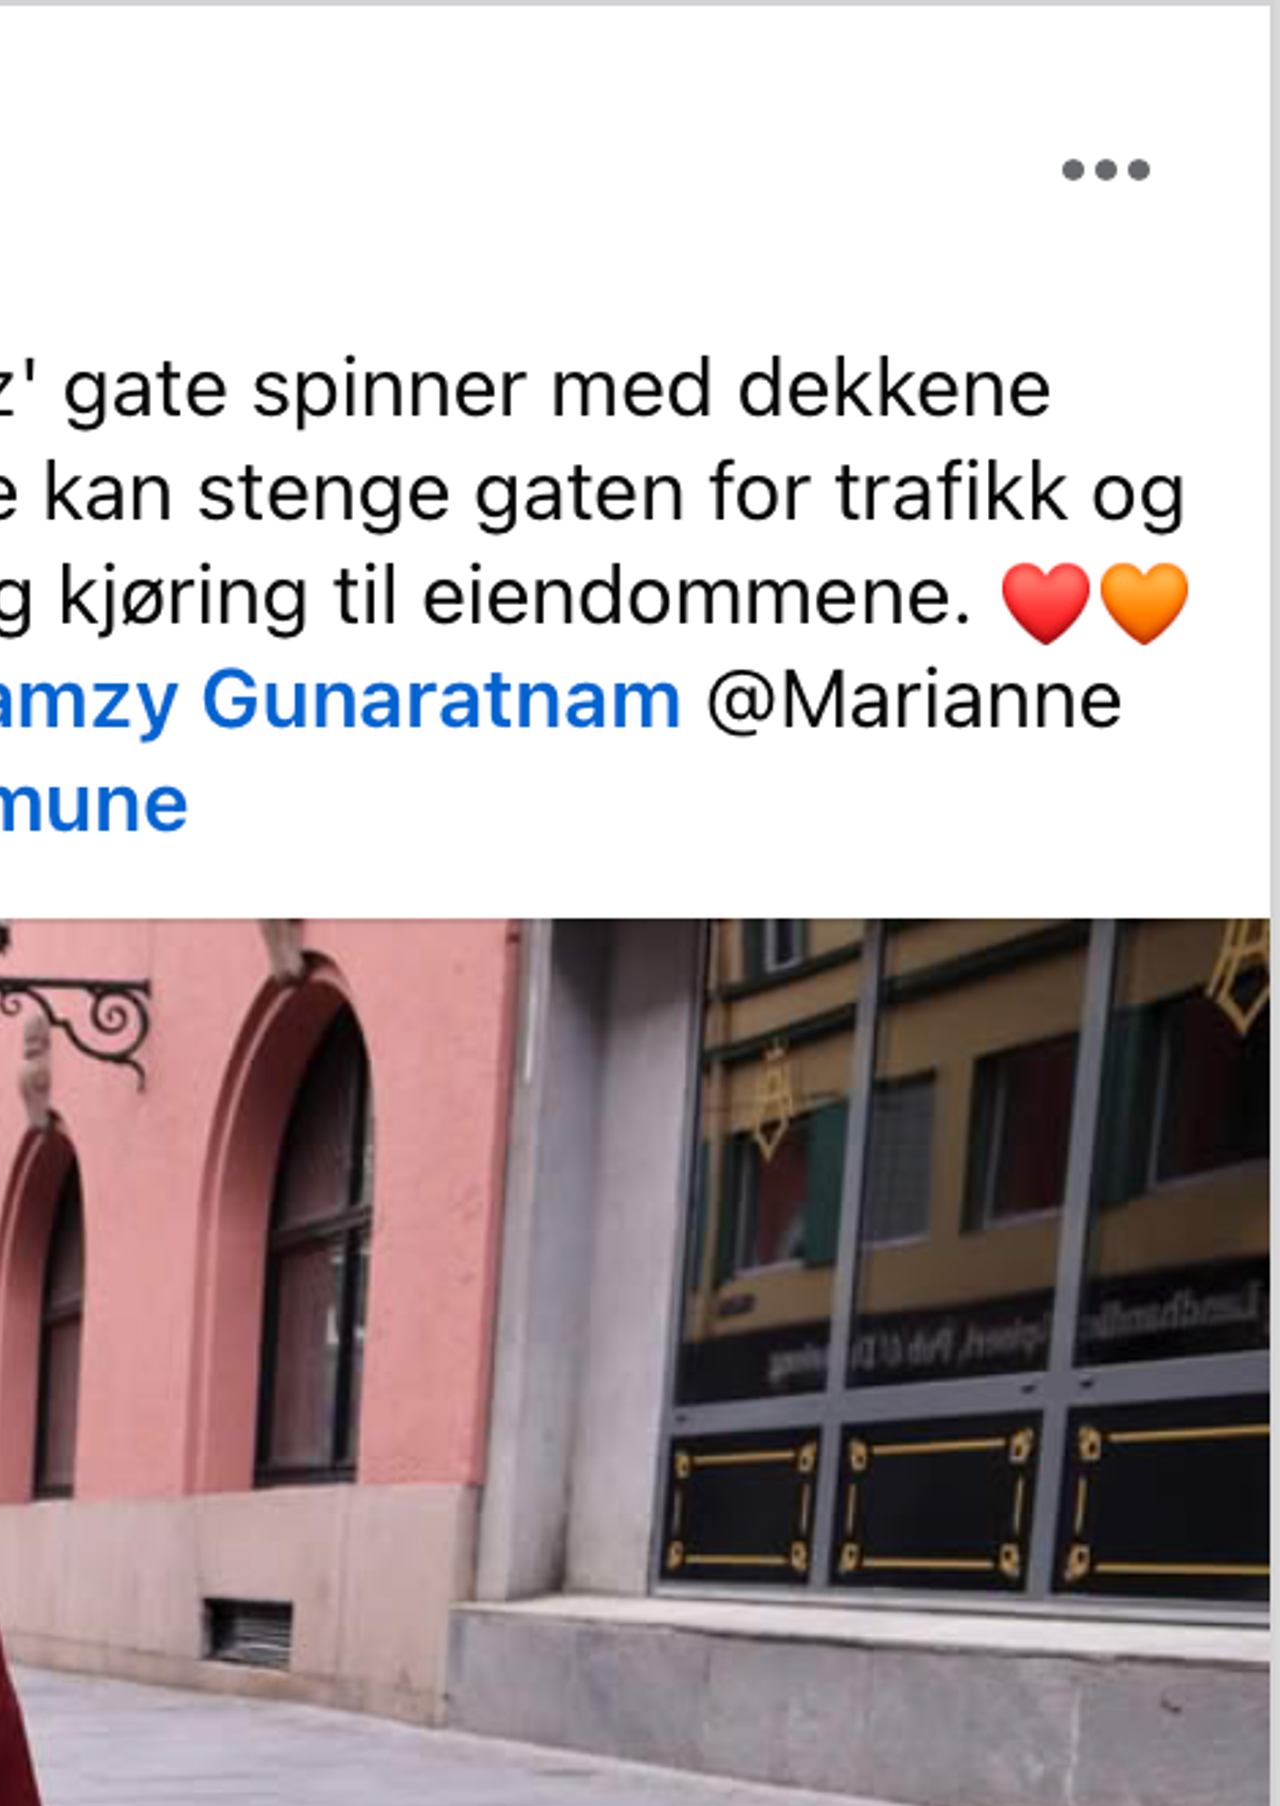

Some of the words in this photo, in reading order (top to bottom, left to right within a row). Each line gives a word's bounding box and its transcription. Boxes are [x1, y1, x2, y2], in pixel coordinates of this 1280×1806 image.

[64, 360, 228, 433] gate
[253, 353, 528, 432] spinner
[553, 354, 711, 418] med
[739, 354, 1050, 418] dekkene
[45, 458, 171, 522] kan
[198, 463, 450, 537] stenge
[475, 463, 683, 537] gaten
[708, 457, 812, 522] for
[834, 457, 1069, 522] trafikk
[1092, 474, 1183, 537] og
[61, 561, 306, 641] kjøring
[332, 561, 395, 625] til
[423, 561, 969, 626] eiendommene.
[202, 666, 680, 730] Gunaratnam
[707, 665, 1121, 739] @Marianne
